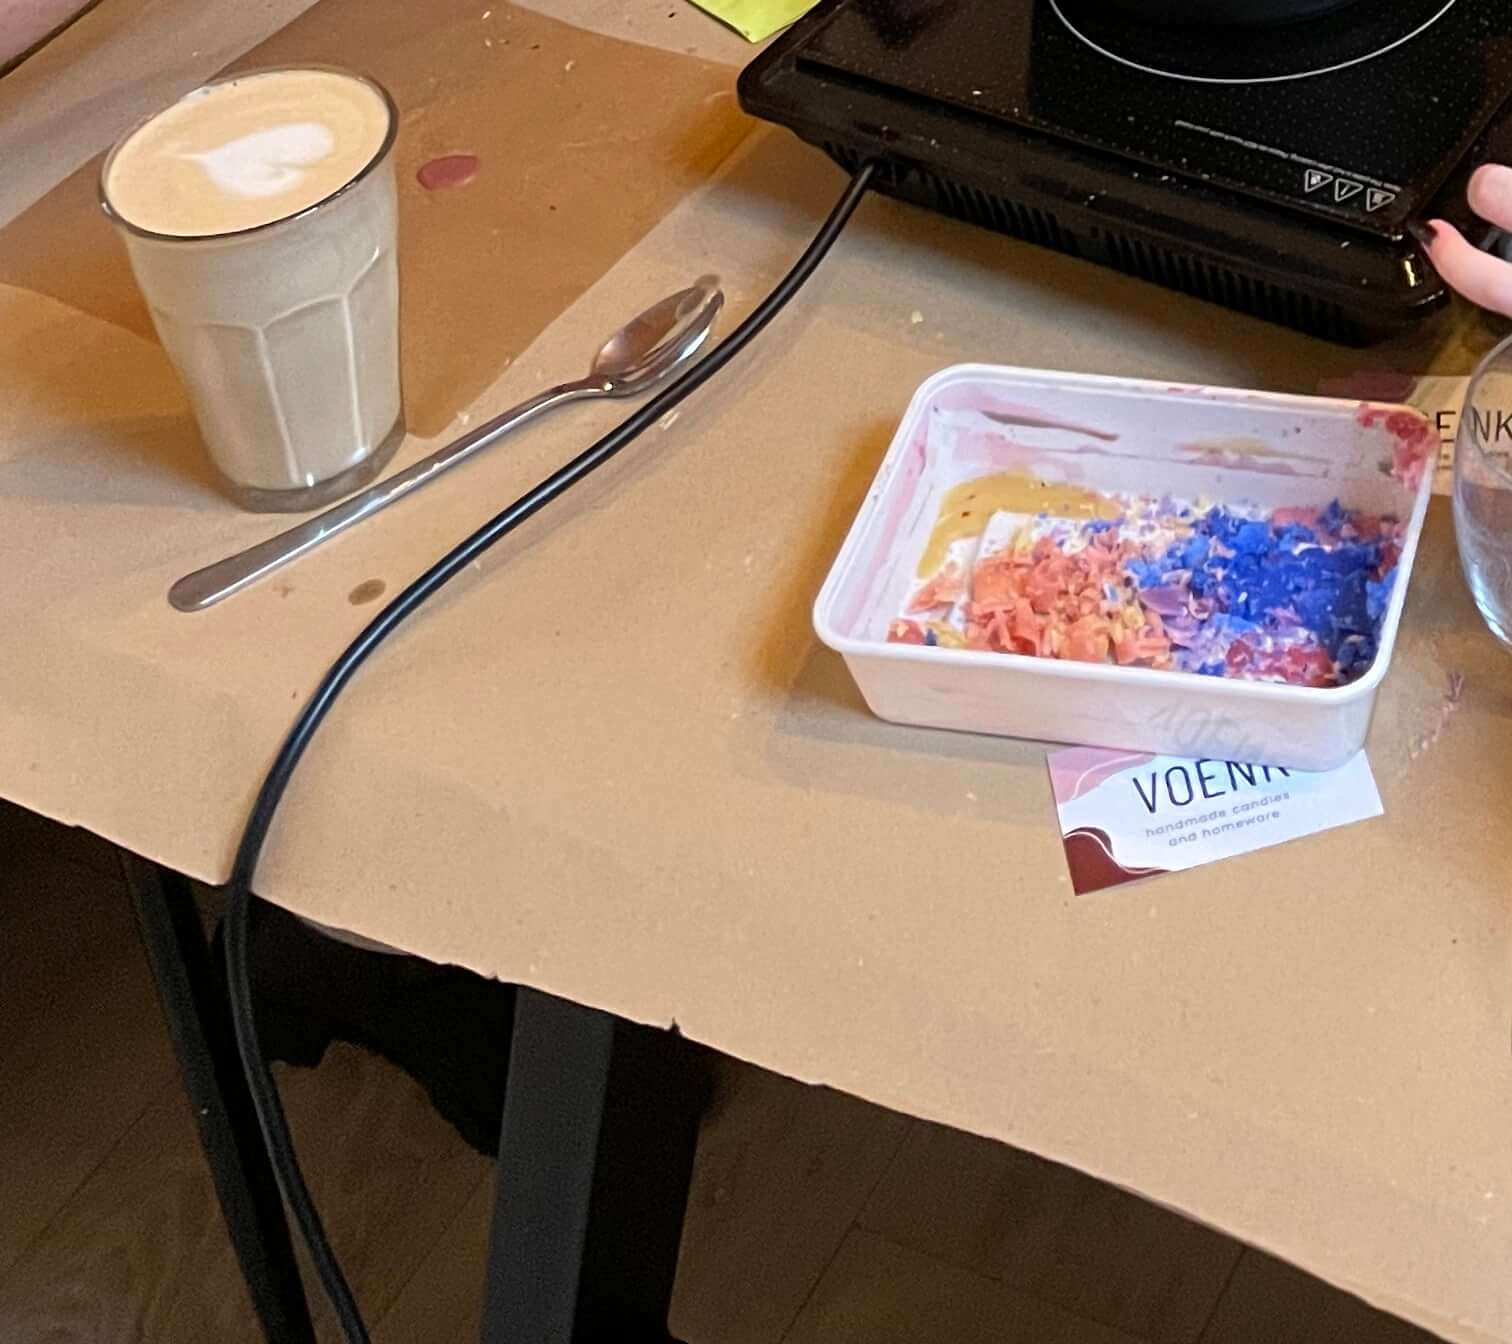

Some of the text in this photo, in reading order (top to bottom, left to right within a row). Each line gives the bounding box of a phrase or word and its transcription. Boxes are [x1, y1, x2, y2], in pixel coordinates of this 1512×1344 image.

[1145, 808, 1228, 838] handmade
[1167, 810, 1281, 848] and homeware
